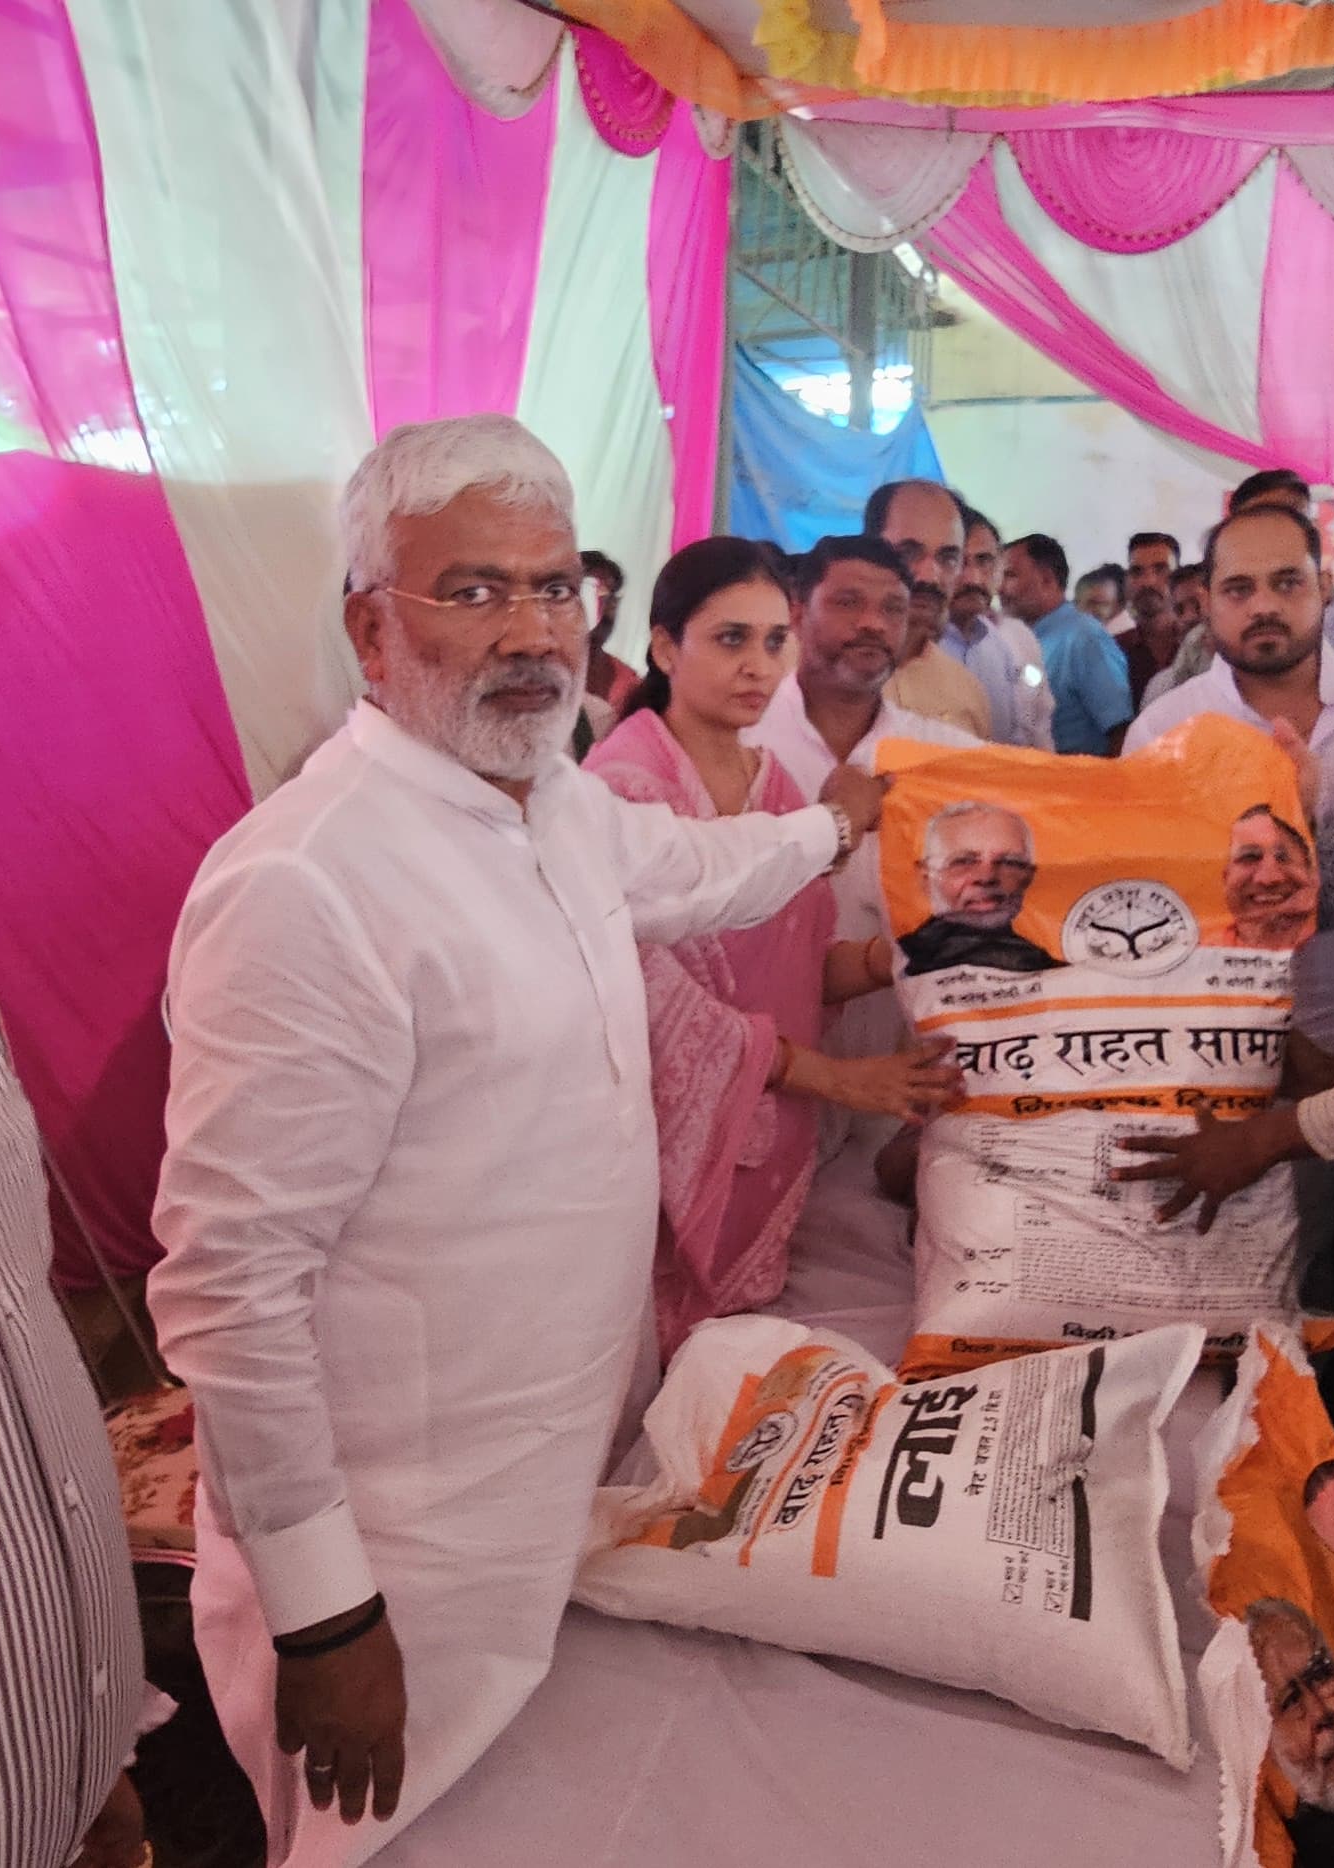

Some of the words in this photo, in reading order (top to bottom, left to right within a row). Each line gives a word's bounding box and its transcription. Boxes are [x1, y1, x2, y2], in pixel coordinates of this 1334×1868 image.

[954, 1033, 1039, 1081] बाढ़
[1055, 1027, 1174, 1077] राहत
[873, 1384, 978, 1540] लाई
[964, 1471, 987, 1496] नेट
